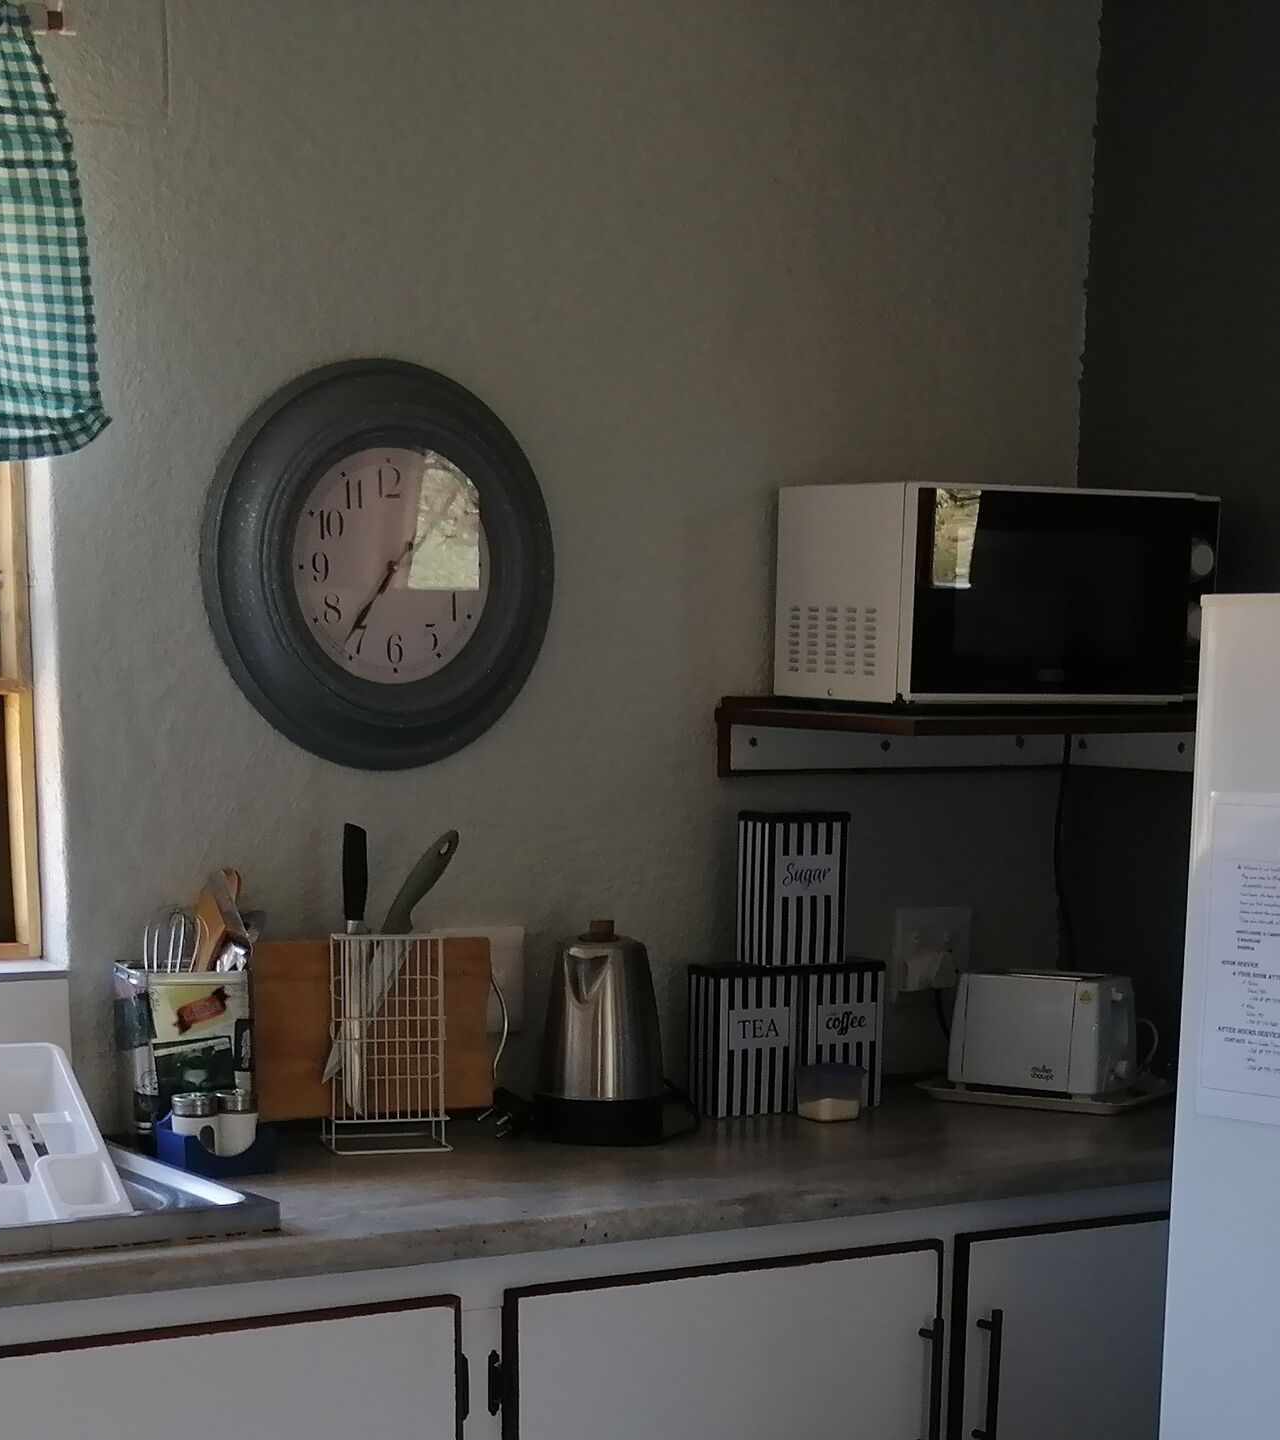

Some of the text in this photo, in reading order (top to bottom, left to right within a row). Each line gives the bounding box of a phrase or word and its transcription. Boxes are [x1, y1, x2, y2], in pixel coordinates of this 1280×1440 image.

[344, 479, 363, 510] 11
[377, 466, 402, 499] 12
[318, 509, 345, 541] 10
[310, 551, 330, 584] 9
[323, 593, 343, 624] 8
[386, 633, 404, 664] 6
[782, 862, 831, 889] Sugar
[737, 1018, 780, 1040] TEA
[825, 1010, 867, 1036] coffee
